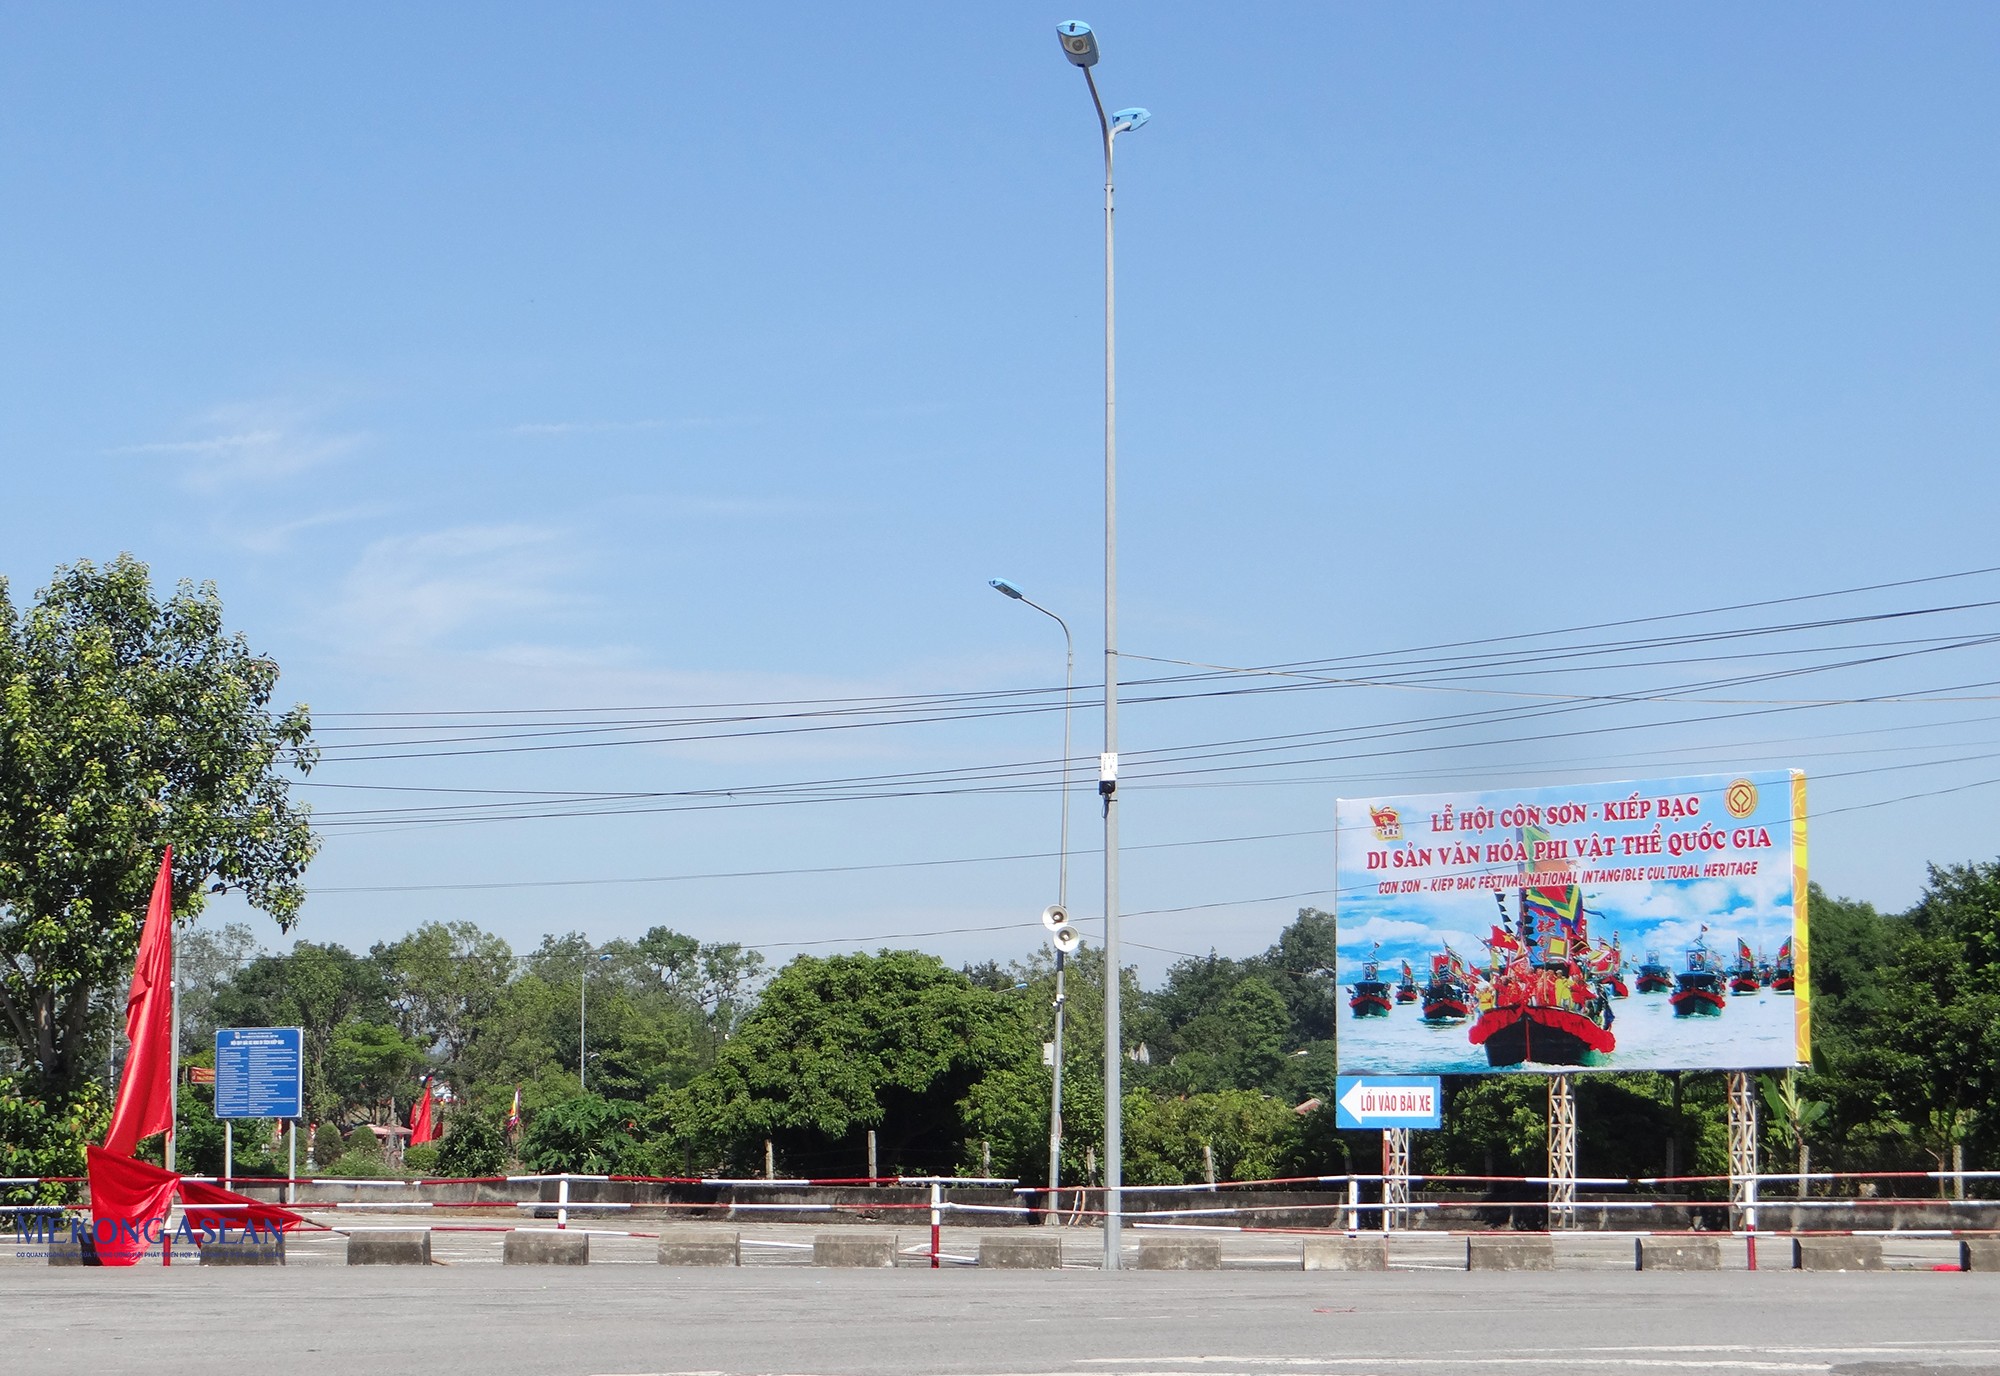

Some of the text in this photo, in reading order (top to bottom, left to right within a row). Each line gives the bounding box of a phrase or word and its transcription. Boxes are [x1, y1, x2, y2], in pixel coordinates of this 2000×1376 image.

[1431, 803, 1453, 832] LỄ
[1460, 805, 1494, 834] HỘI
[1500, 802, 1541, 828] CÔN
[1546, 801, 1587, 826] SƠN
[1603, 792, 1652, 821] KIẾP
[1657, 796, 1700, 822] BẠC
[1366, 822, 1772, 870] DI SẢN VĂN HÓA PHI VẬT THỂ QUỐC GIA
[1430, 877, 1455, 892] KIEP
[1456, 876, 1476, 890] BAC
[1478, 872, 1524, 889] FESTIVAL
[1526, 870, 1578, 886] NATIONAL
[1581, 867, 1645, 884] INTANGIBLE
[1647, 864, 1700, 880] CULTURAL
[1703, 861, 1758, 877] HERITAGE
[1361, 1088, 1431, 1112] LỐI VÀO BÃI XE
